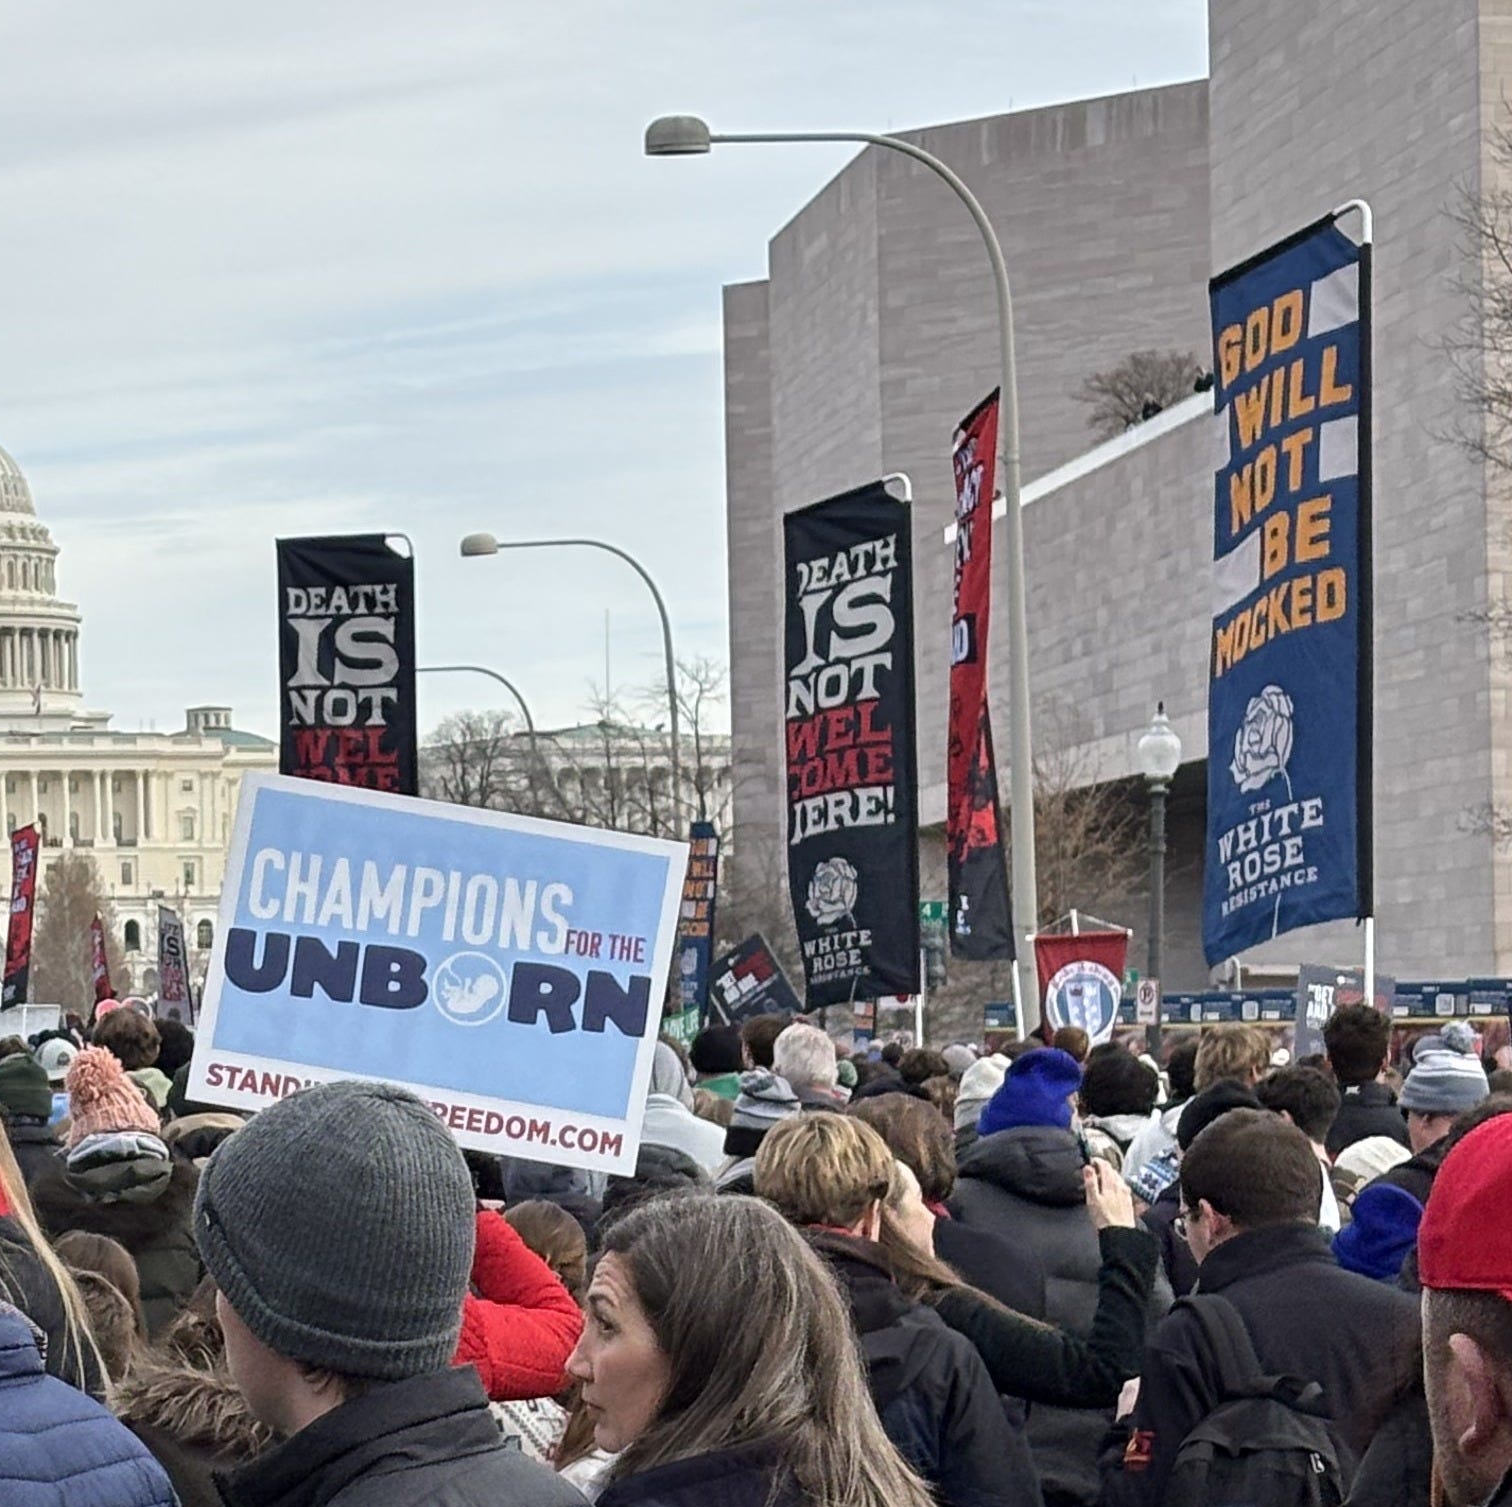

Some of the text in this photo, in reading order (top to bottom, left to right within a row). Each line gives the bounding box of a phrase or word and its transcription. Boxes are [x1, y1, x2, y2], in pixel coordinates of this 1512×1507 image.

[1219, 289, 1303, 389] GOD
[1233, 345, 1351, 447] WILL
[1228, 426, 1314, 534] NOT
[1261, 494, 1331, 586] BE
[287, 583, 399, 616] DEATH
[790, 572, 895, 677] IS
[1215, 567, 1347, 676] MOCKED
[287, 616, 400, 687] IS
[289, 687, 398, 726] NOT
[787, 652, 892, 719] NOT
[293, 727, 399, 767] WEL
[788, 702, 892, 758] WEL
[1217, 797, 1324, 864] WHITE
[1227, 836, 1305, 893] ROSE
[248, 848, 647, 964] CHAMPIONS FOR THE
[803, 929, 872, 958] WHITE
[813, 949, 862, 974] ROSE
